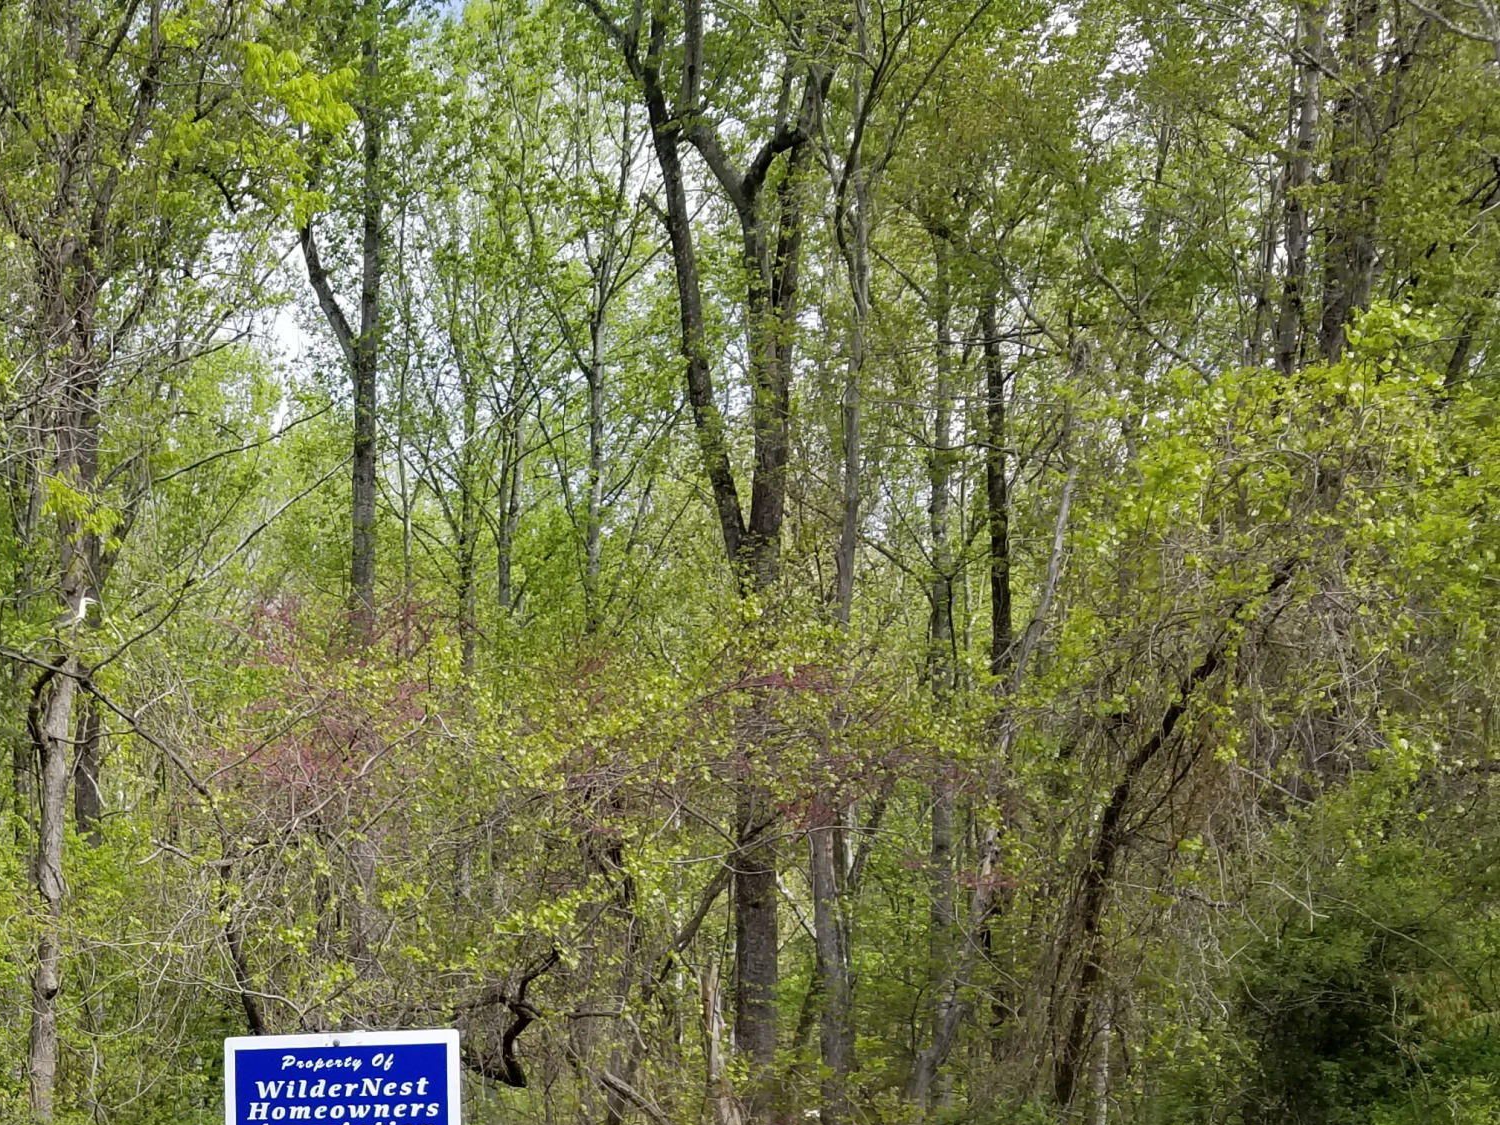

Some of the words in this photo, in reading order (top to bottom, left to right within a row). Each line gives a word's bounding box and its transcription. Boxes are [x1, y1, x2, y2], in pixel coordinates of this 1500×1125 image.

[281, 1055, 362, 1072] Property
[371, 1053, 395, 1071] Of
[255, 1077, 429, 1099] WilderNest
[247, 1102, 440, 1120] Homeowners
